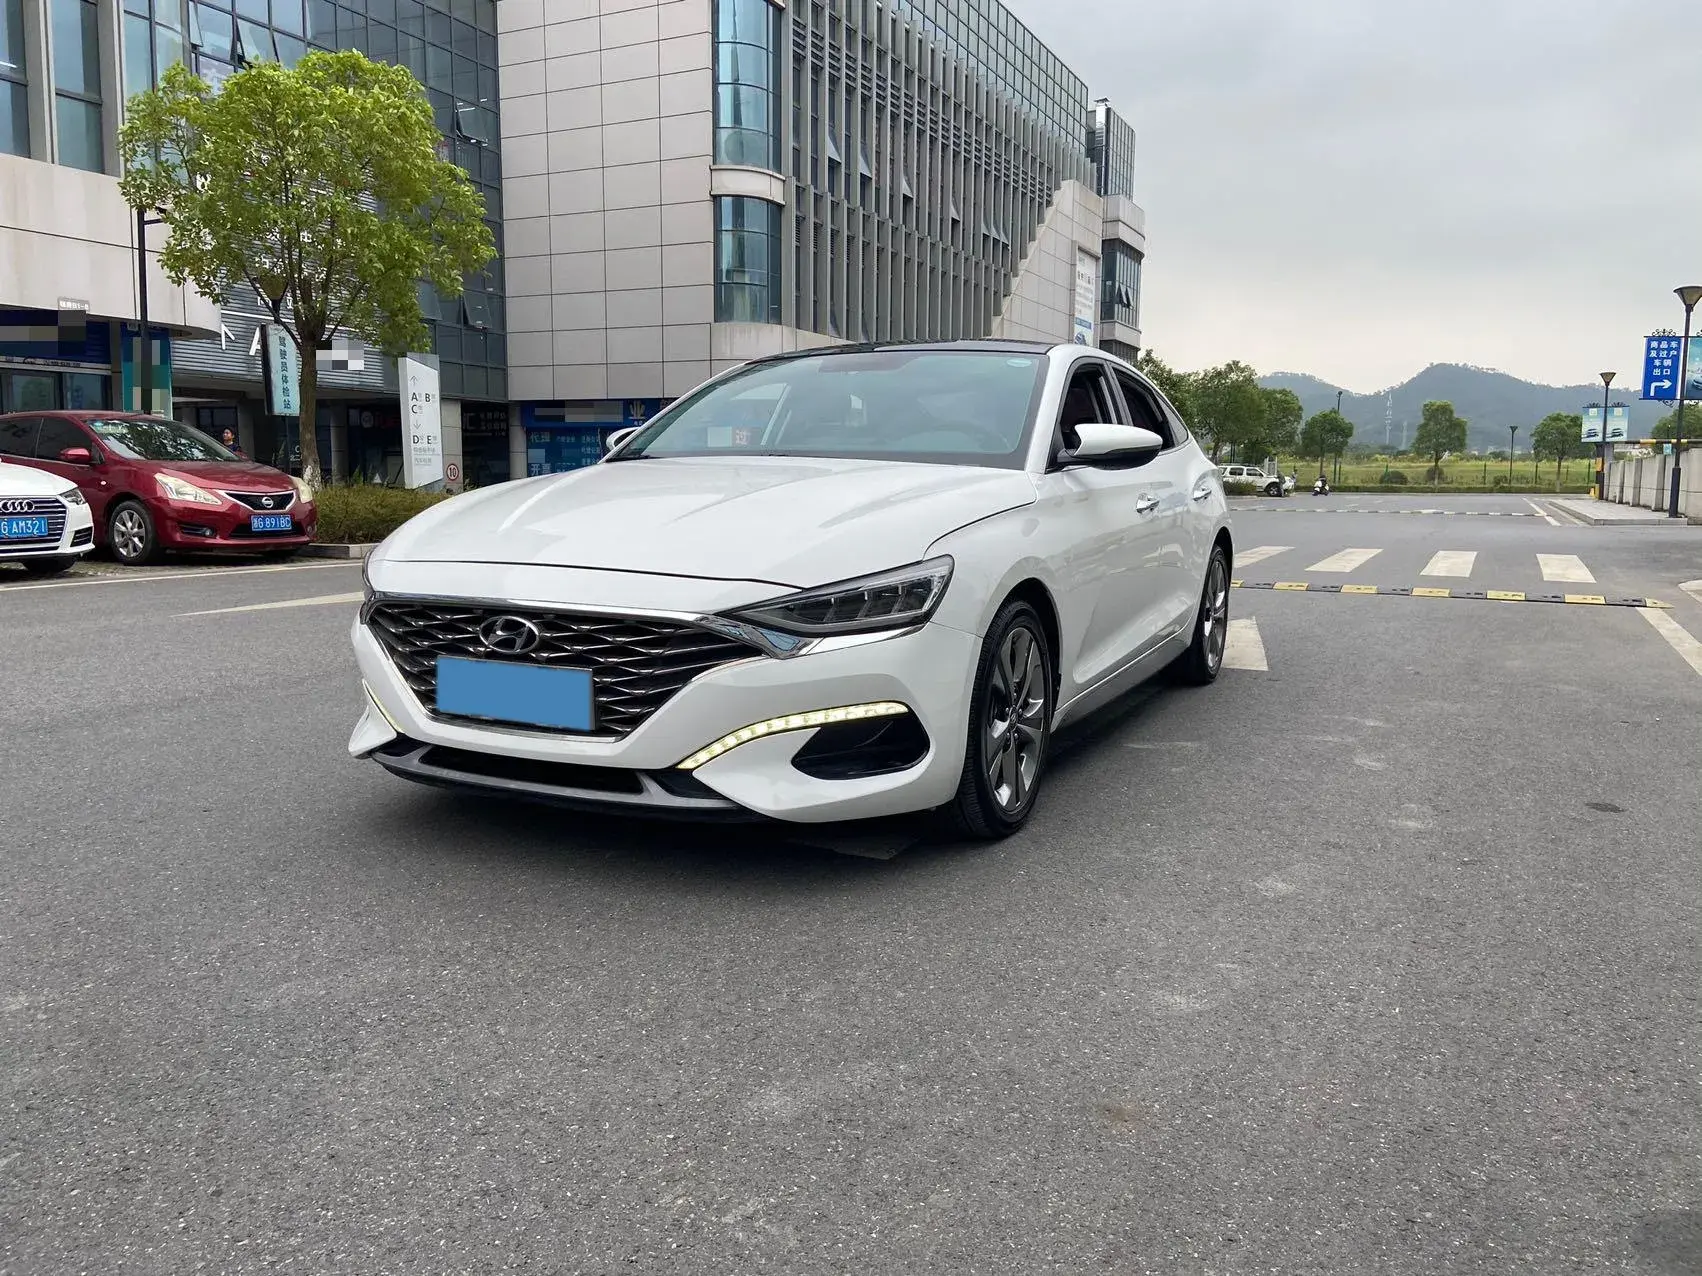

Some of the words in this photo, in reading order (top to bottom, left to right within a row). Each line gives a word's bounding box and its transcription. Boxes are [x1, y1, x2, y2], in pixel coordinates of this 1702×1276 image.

[1650, 341, 1678, 349] 商品车
[1649, 350, 1678, 358] 及过户
[1653, 359, 1672, 367] 车辆
[1653, 368, 1671, 376] 出口
[411, 392, 418, 402] A
[425, 392, 431, 403] B
[411, 404, 418, 414] C
[412, 435, 420, 445] D
[427, 435, 432, 445] E
